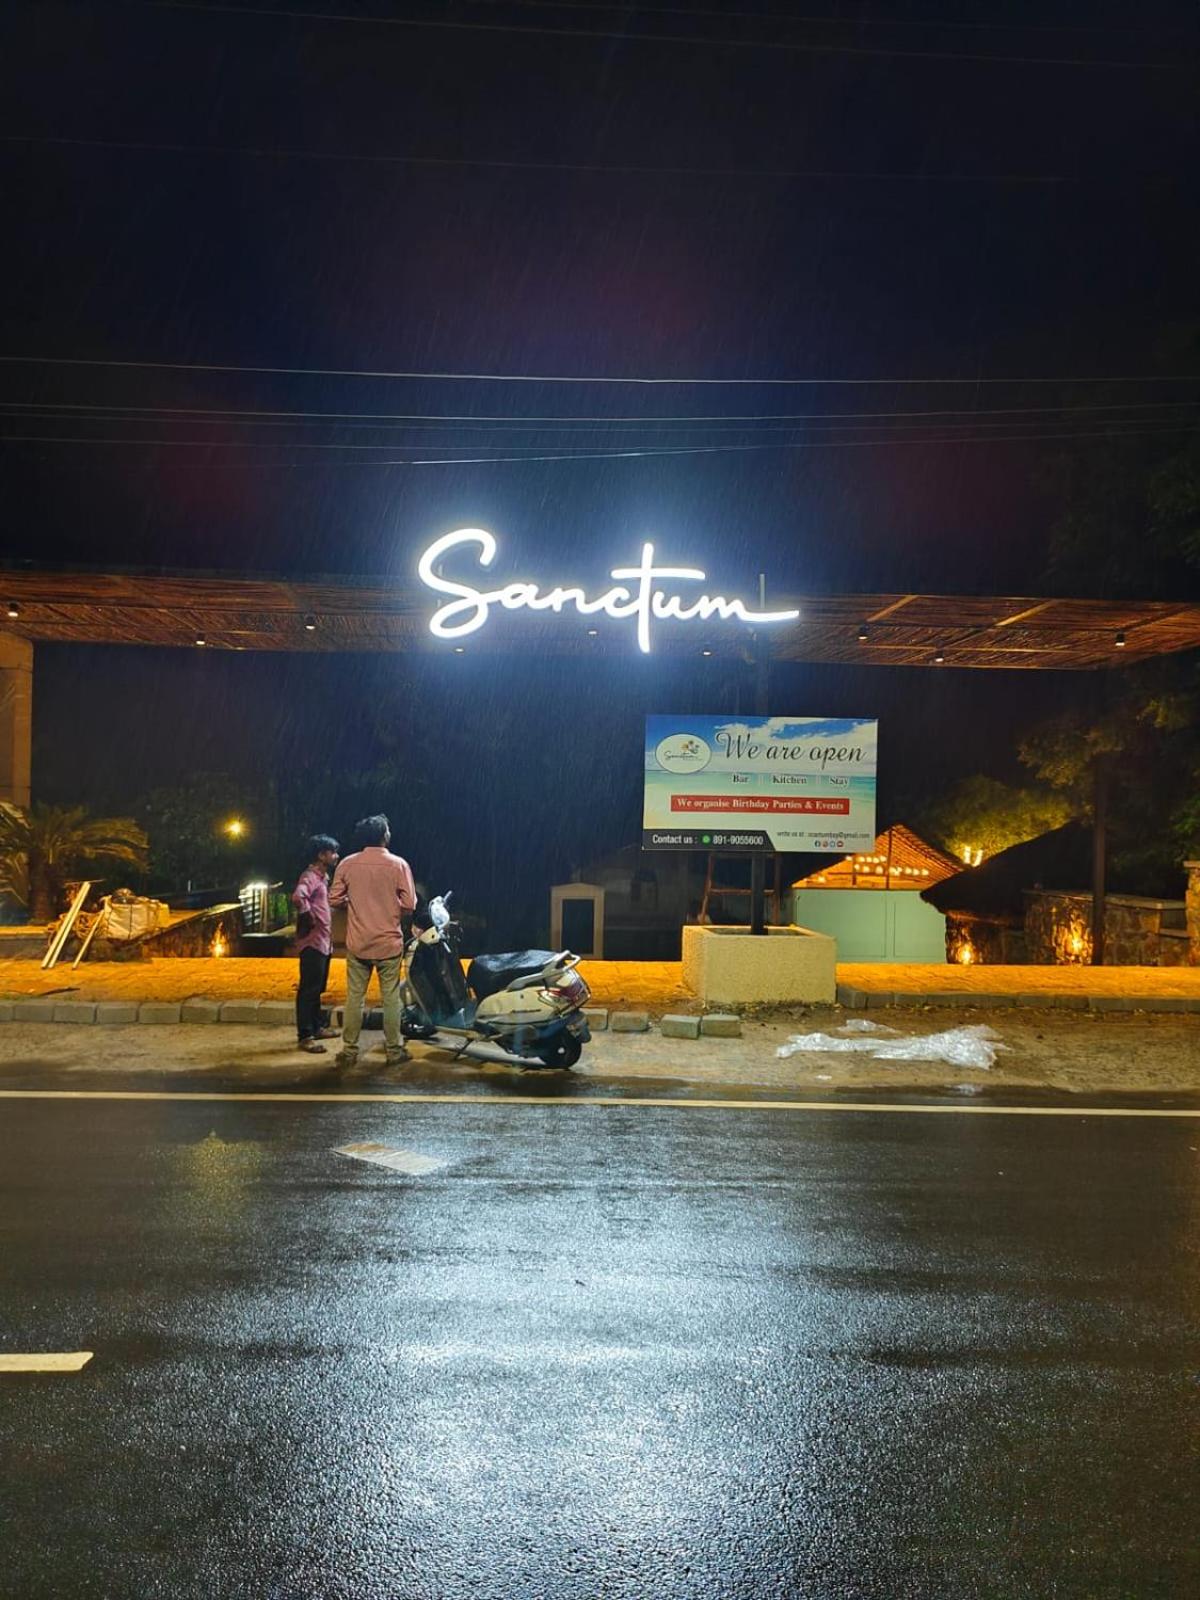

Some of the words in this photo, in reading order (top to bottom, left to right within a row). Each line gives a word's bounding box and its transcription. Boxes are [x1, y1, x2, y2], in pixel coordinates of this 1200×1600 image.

[418, 528, 800, 653] Sanctum
[715, 732, 760, 760] We
[766, 743, 802, 760] are
[809, 745, 867, 770] open
[733, 775, 749, 783] Bar
[772, 775, 807, 784] Kitchen
[829, 777, 848, 787] Stay
[677, 798, 691, 807] We
[693, 799, 730, 809] organise
[732, 799, 769, 809] Birthday
[772, 800, 801, 809] Parties
[804, 801, 812, 809] &
[816, 801, 844, 810] Events
[652, 834, 682, 844] Contact
[683, 836, 693, 844] us
